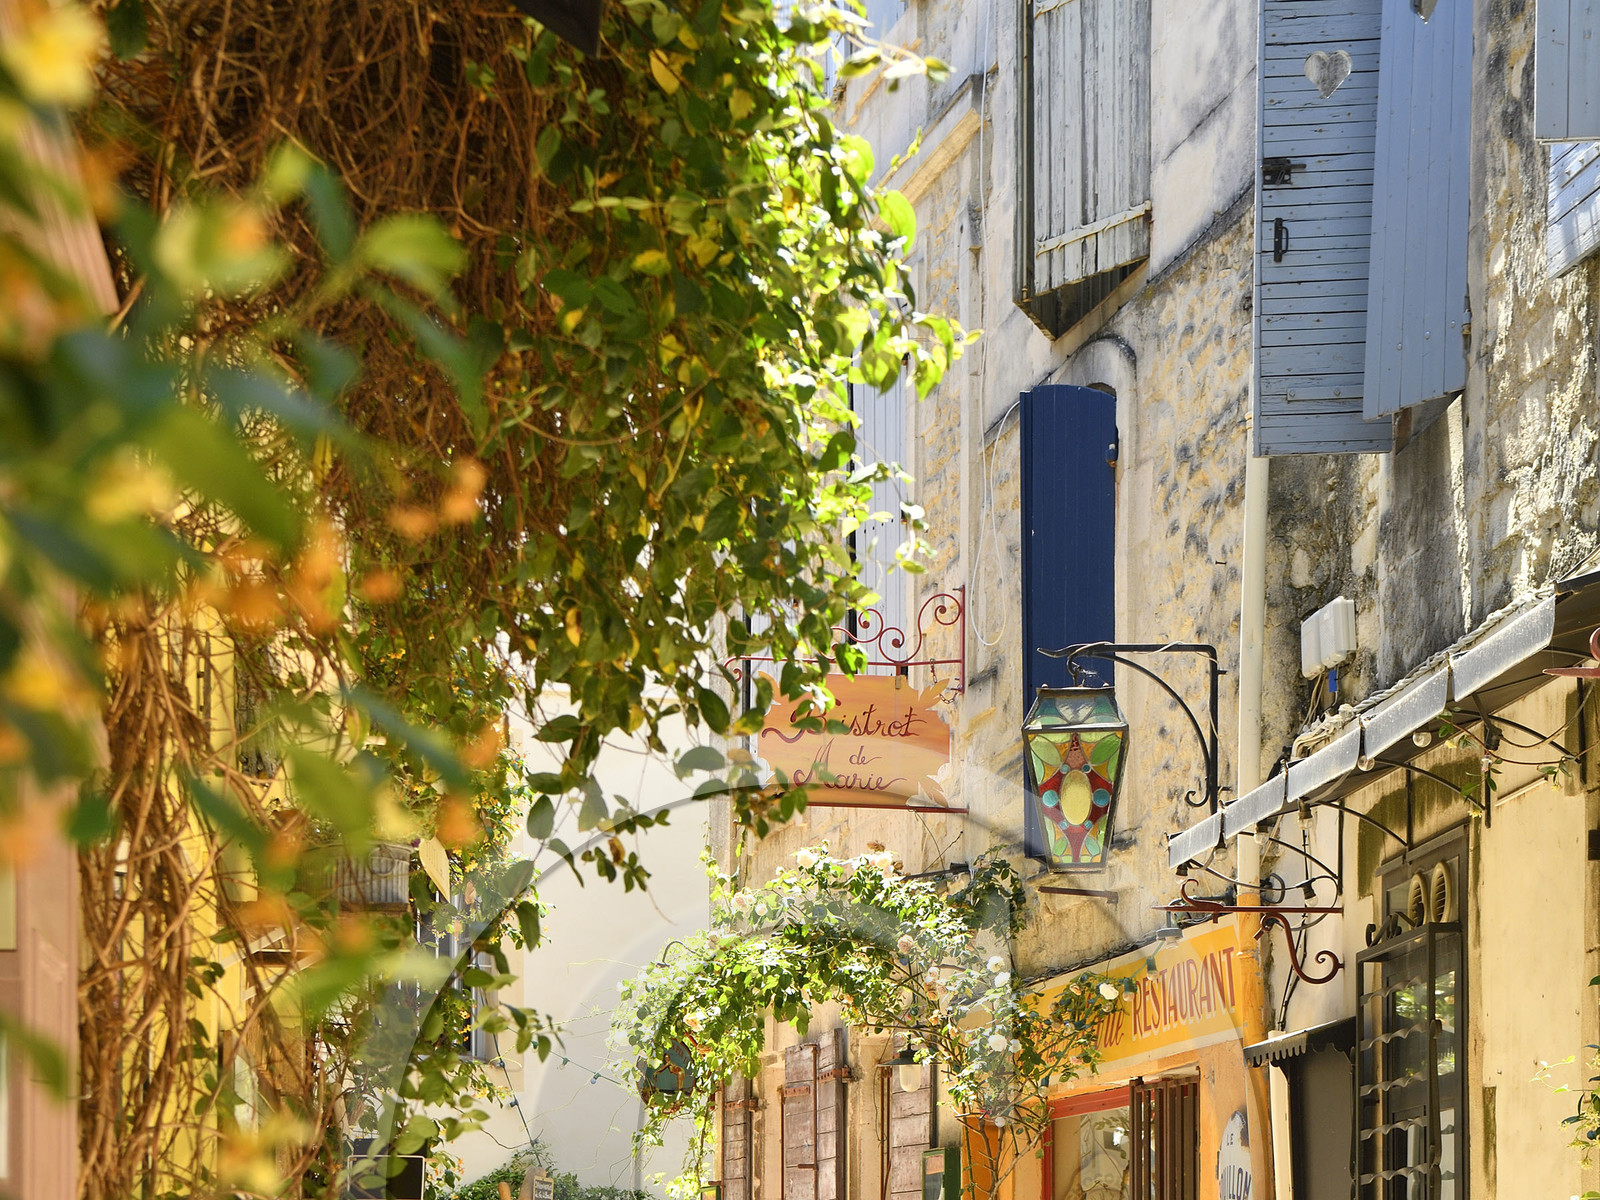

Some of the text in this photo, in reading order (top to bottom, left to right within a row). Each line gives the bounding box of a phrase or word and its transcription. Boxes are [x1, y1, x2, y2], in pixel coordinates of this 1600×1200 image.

[793, 737, 907, 790] Marie
[849, 745, 882, 765] de
[1132, 946, 1236, 1039] RESTAURANT
